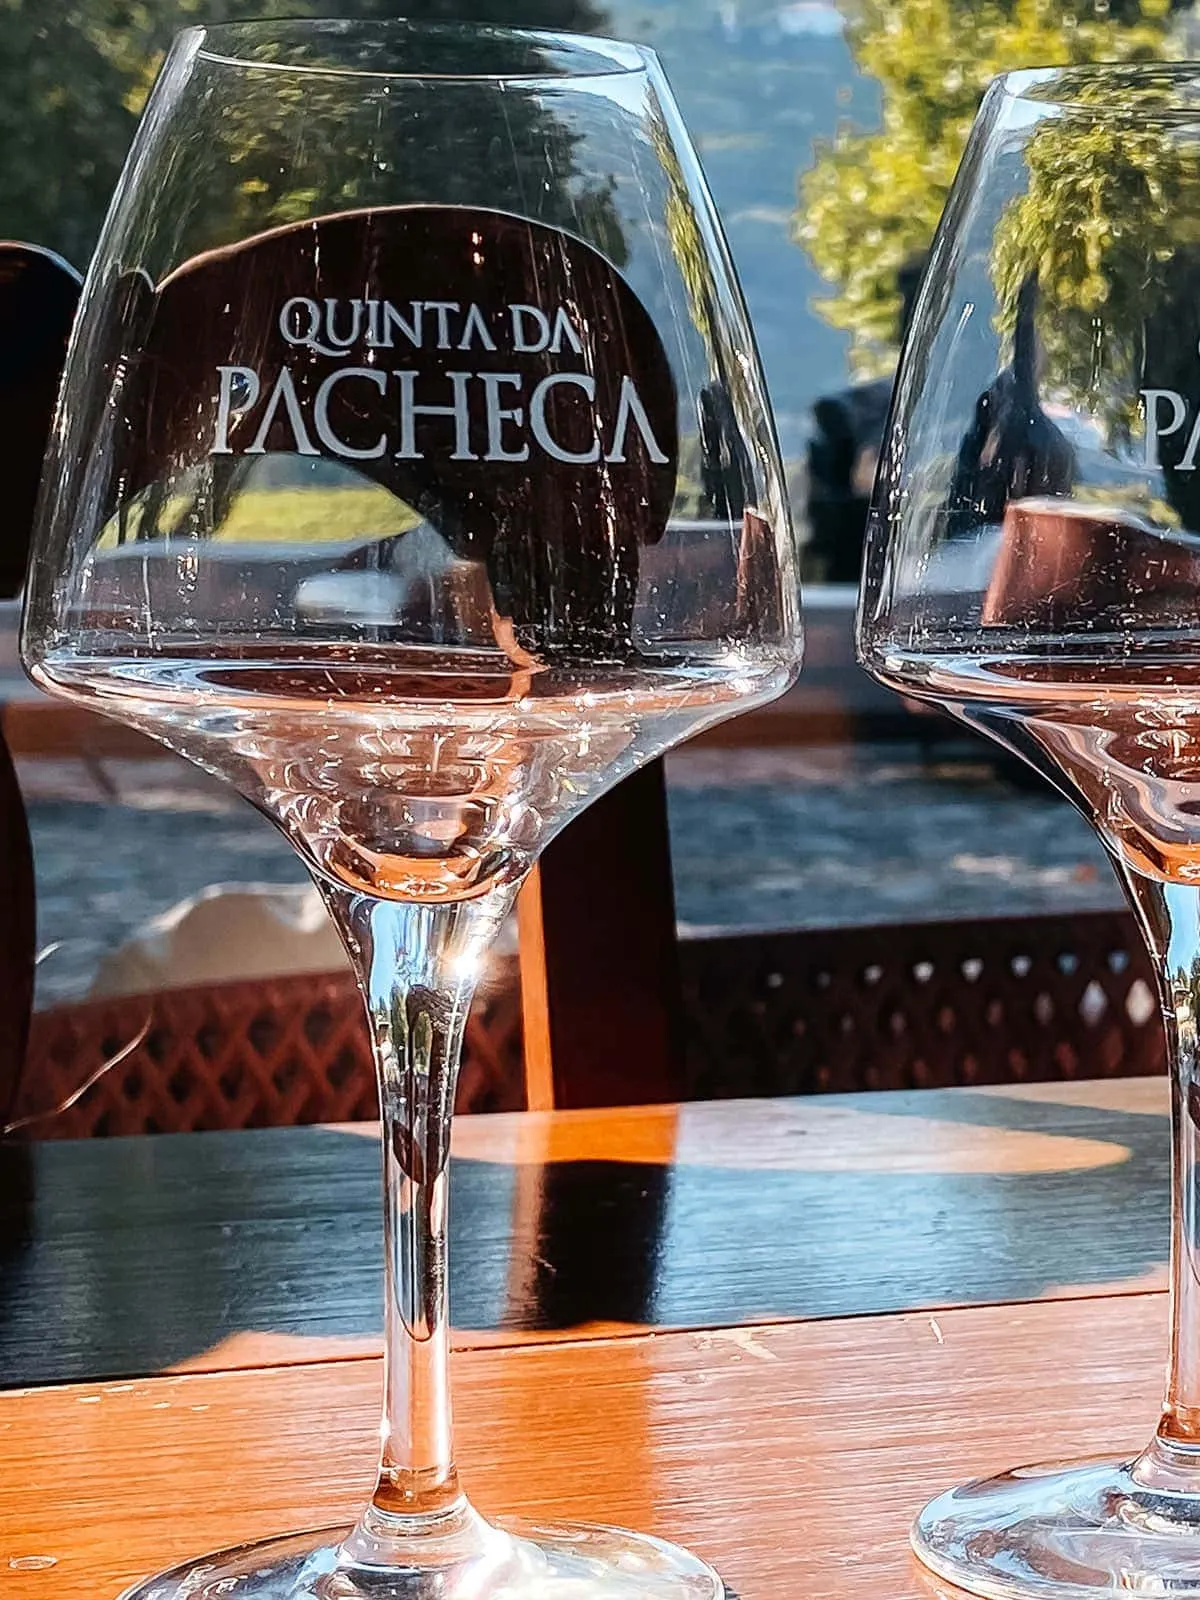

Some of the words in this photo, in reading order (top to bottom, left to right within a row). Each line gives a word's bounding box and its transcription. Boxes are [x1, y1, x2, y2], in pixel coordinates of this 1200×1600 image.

[279, 296, 497, 357] QUINTA
[507, 303, 583, 354] DA
[208, 365, 669, 463] PACHECA
